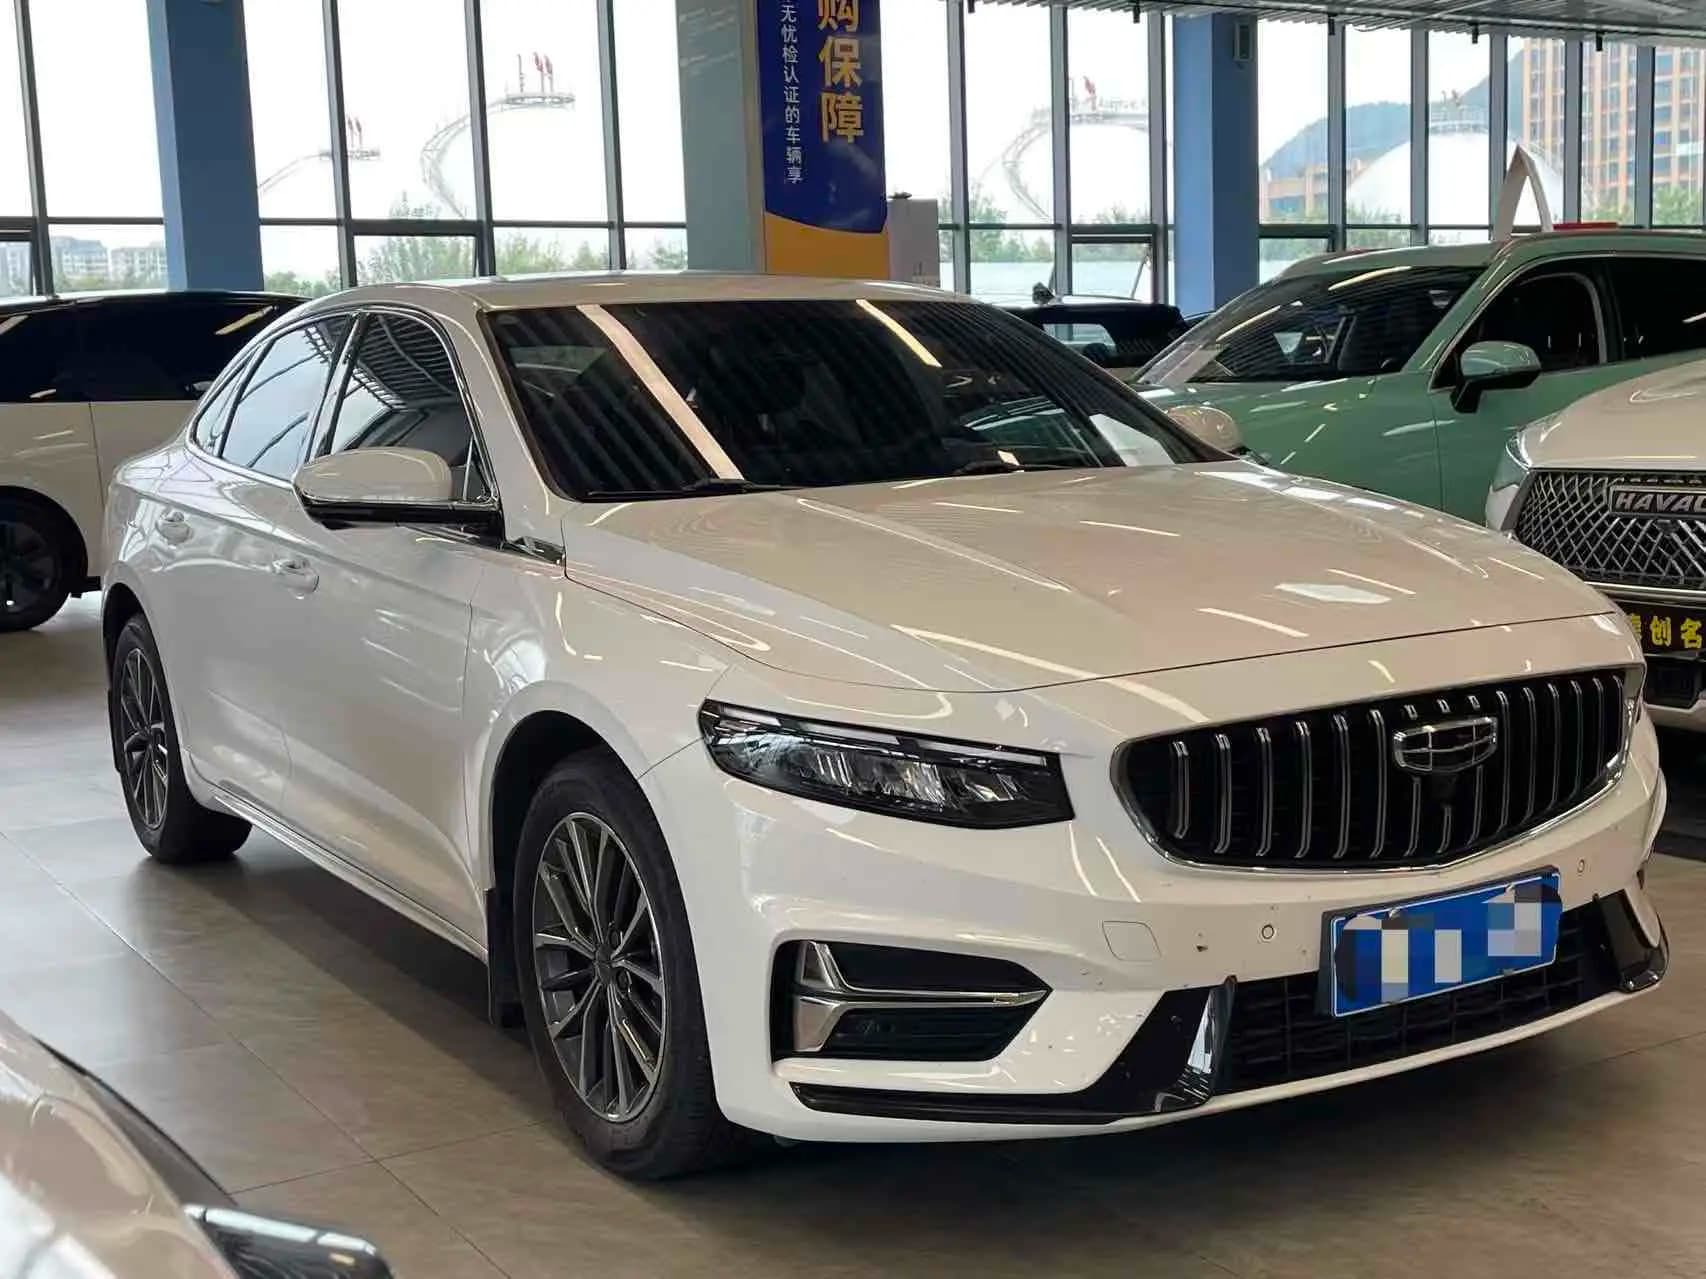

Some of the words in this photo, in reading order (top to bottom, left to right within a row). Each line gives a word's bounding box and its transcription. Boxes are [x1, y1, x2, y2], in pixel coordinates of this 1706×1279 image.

[780, 0, 802, 184] 无忧检认证的车辆享
